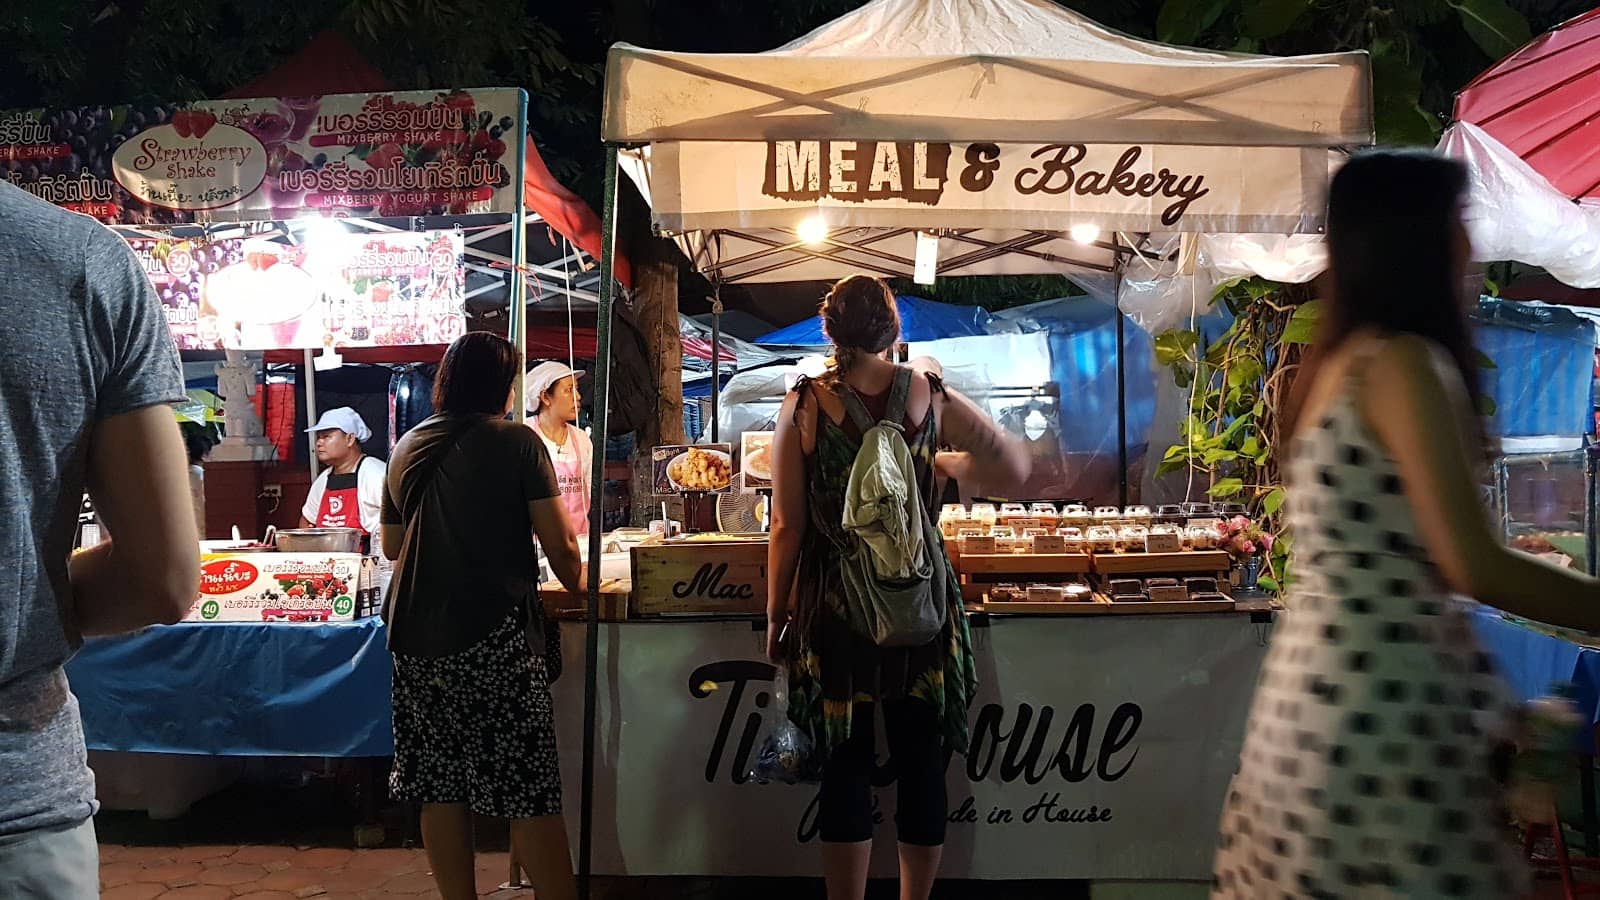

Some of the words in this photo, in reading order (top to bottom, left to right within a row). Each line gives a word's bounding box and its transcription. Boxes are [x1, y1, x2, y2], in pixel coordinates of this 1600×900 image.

[337, 132, 398, 145] MIXBERRY
[403, 130, 442, 142] SHAKE
[26, 146, 61, 157] SHAKE
[133, 138, 252, 171] Strawberry
[774, 140, 941, 194] MEAL
[960, 142, 1001, 193] &
[1014, 143, 1210, 226] Bakery
[323, 193, 383, 206] MIXBERRY
[390, 191, 438, 204] YOGURT
[443, 190, 479, 202] SHAKE
[672, 562, 754, 599] Mac
[203, 604, 217, 614] 40
[336, 599, 350, 610] 40
[986, 801, 1013, 824] in
[1022, 791, 1113, 824] House
